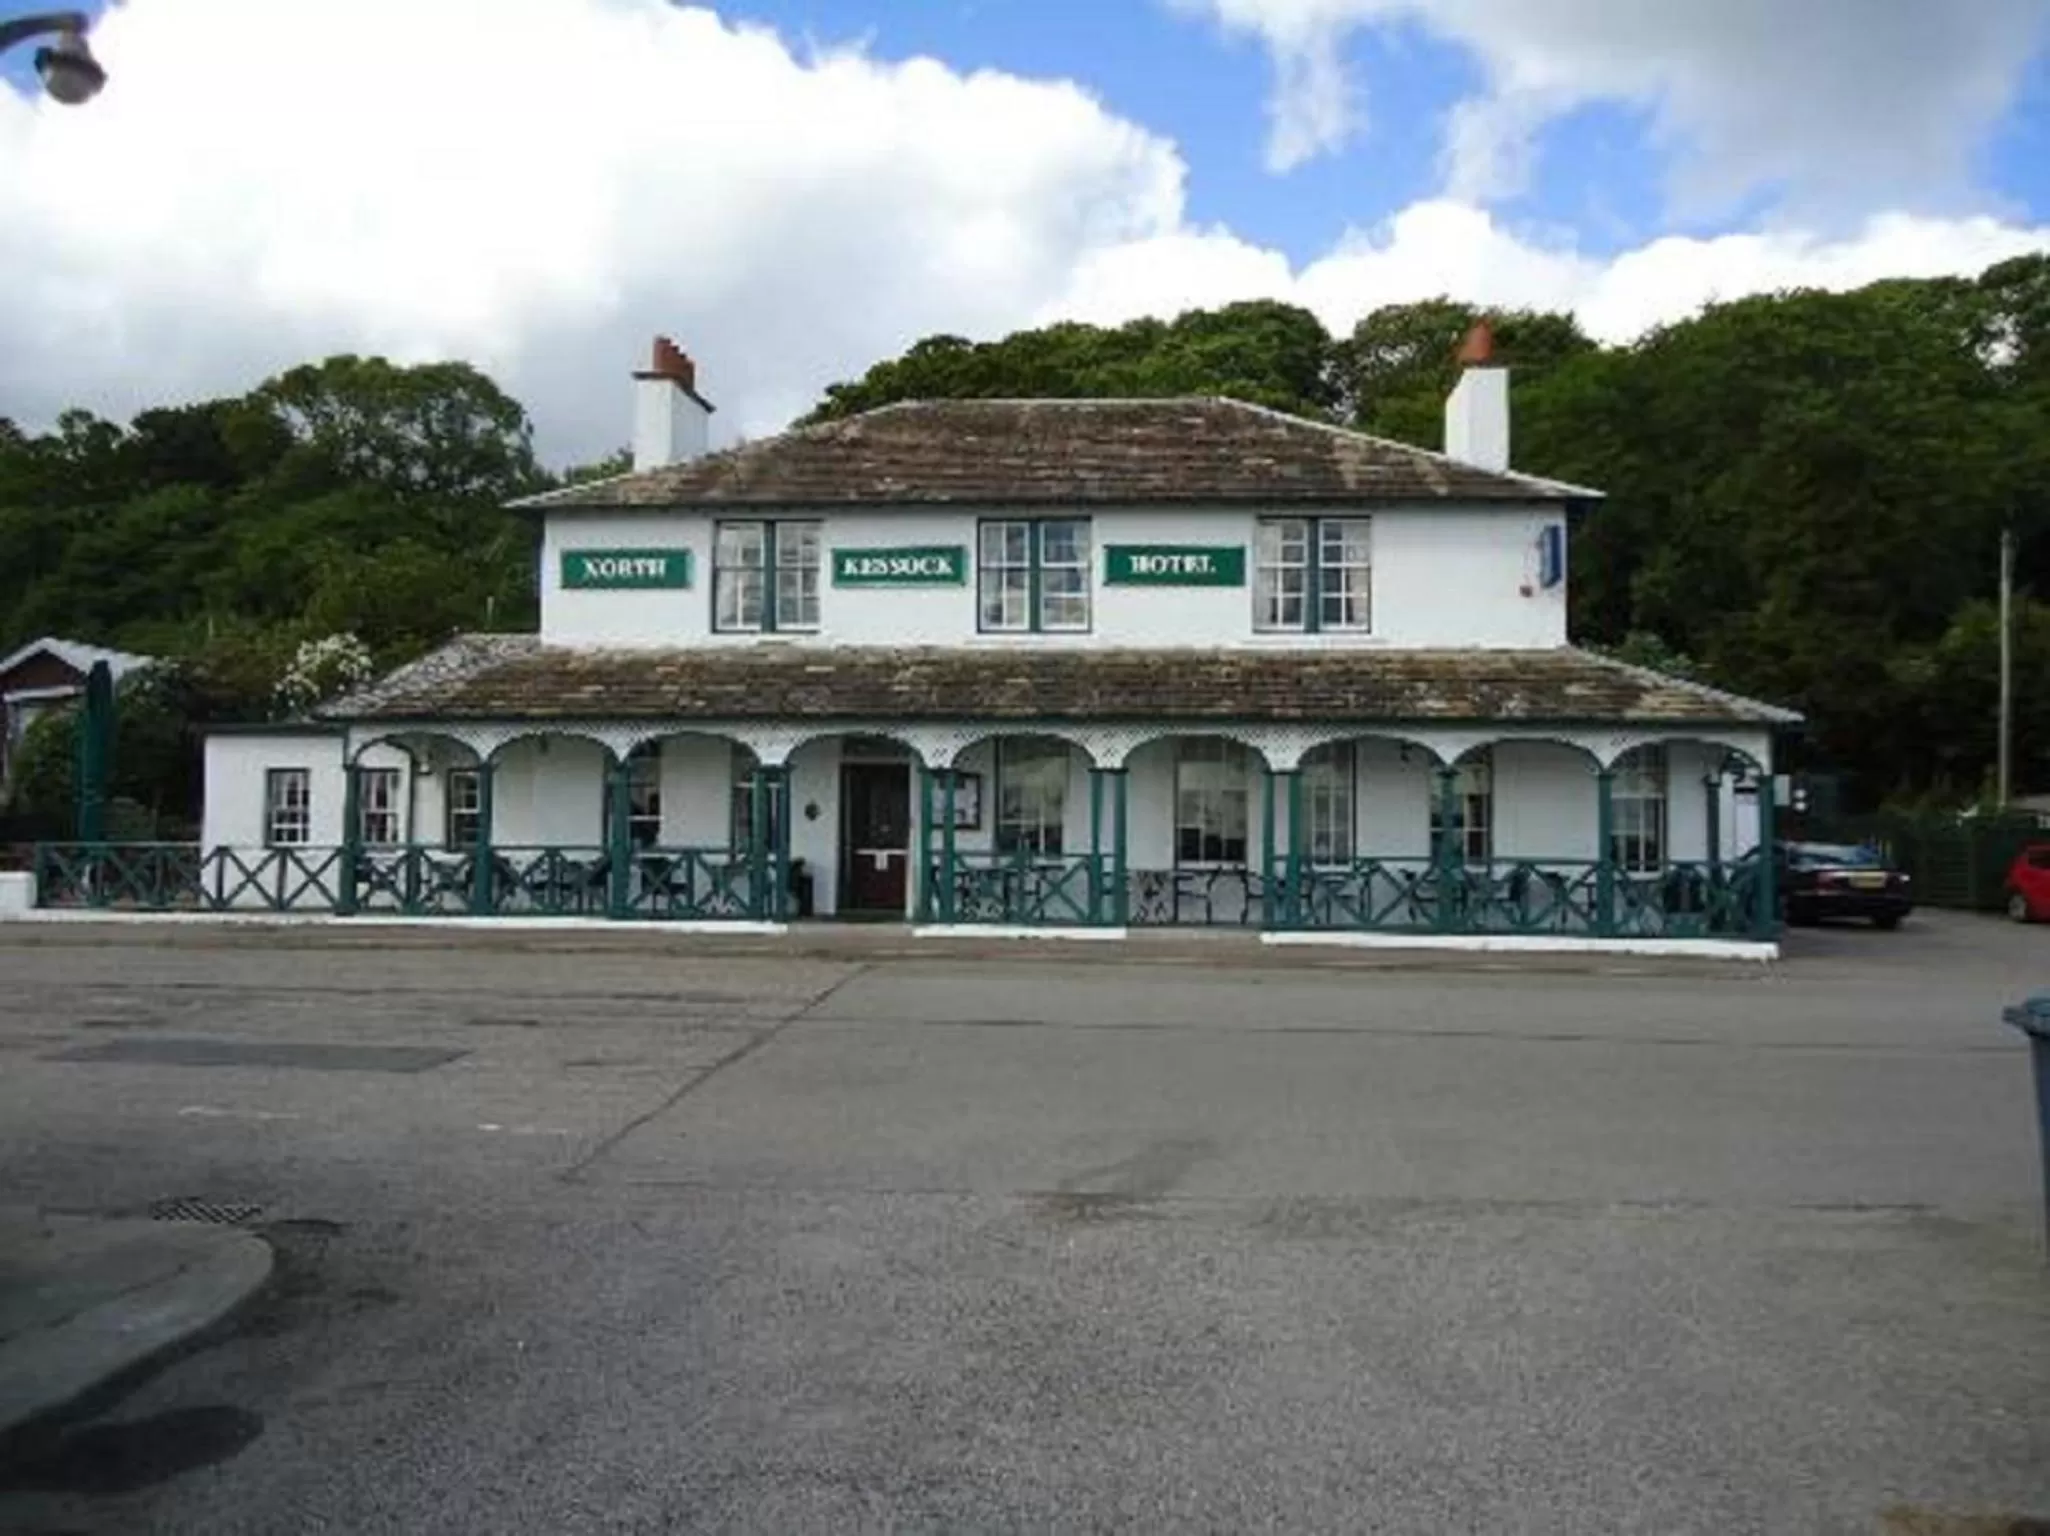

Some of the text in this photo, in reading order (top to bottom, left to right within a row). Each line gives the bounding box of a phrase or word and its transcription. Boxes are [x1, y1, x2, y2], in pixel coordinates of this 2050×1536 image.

[581, 557, 666, 578] NORTH
[843, 556, 954, 576] KESSOCK
[1129, 554, 1216, 574] HOTEL
